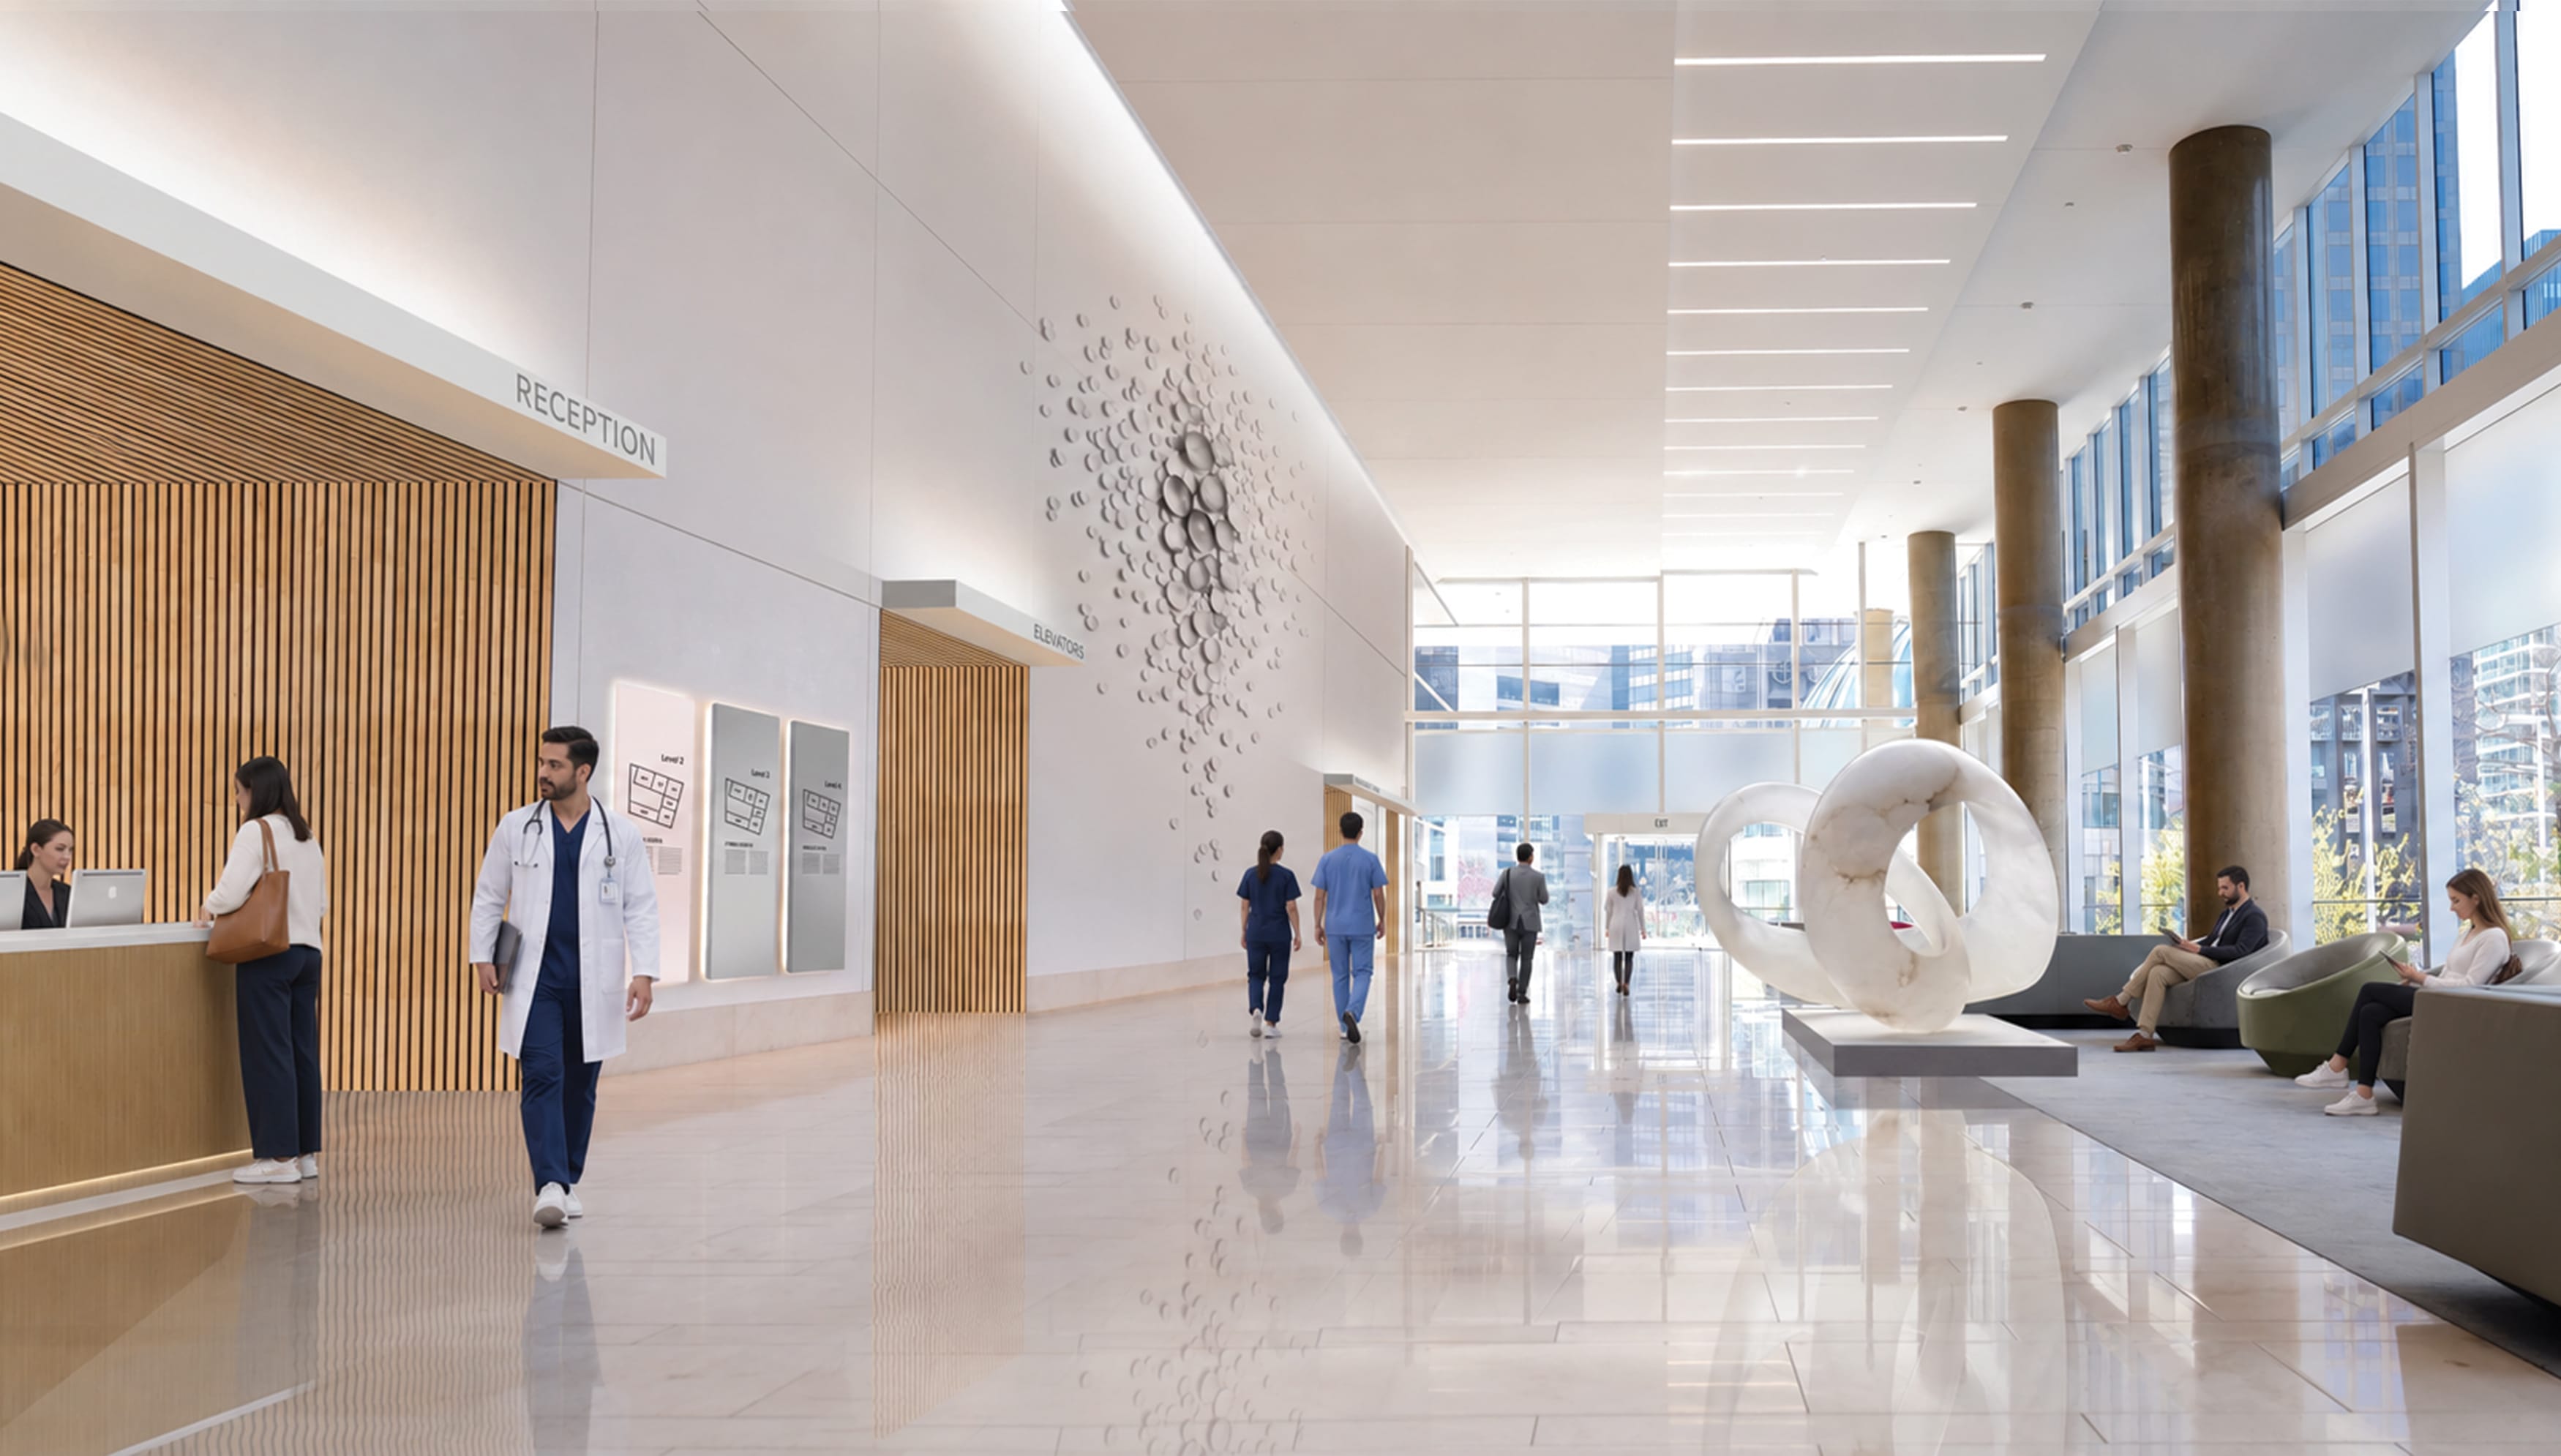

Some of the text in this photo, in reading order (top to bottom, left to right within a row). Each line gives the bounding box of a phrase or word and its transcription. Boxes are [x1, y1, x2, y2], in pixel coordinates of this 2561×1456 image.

[516, 372, 656, 466] RECEPTION
[1034, 623, 1084, 659] ELEVATORS
[661, 754, 678, 764] Level
[1654, 818, 1668, 828] EXIT
